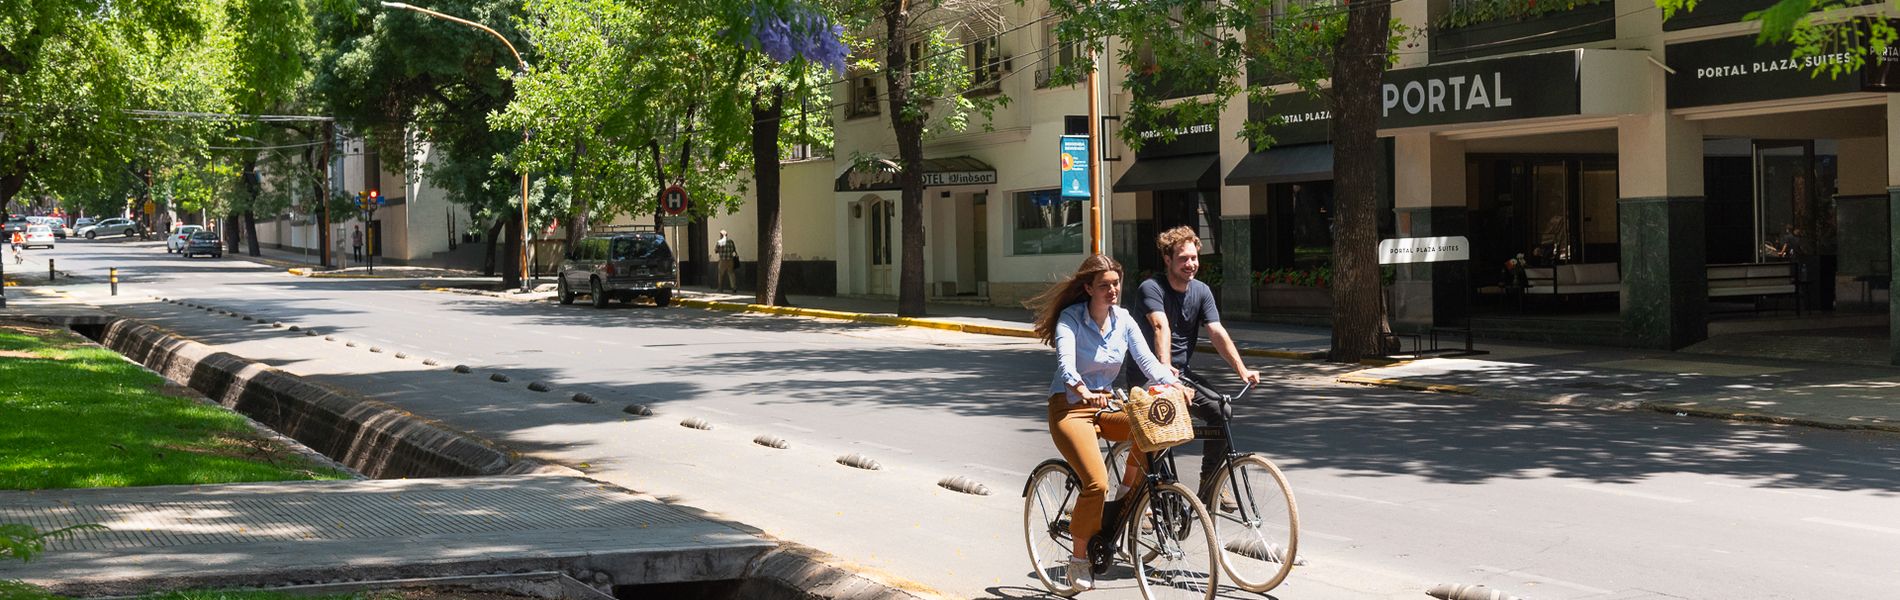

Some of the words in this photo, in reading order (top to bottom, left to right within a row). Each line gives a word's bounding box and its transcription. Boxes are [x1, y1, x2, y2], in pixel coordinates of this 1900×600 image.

[1697, 64, 1747, 79] PORTAL
[1753, 59, 1798, 73] PLAZA
[1805, 52, 1850, 67] SUITES
[1382, 72, 1512, 117] PORTAL
[1305, 110, 1332, 122] PLAZA
[1190, 124, 1213, 133] SUITES
[949, 171, 992, 183] Windsor
[668, 193, 681, 208] H
